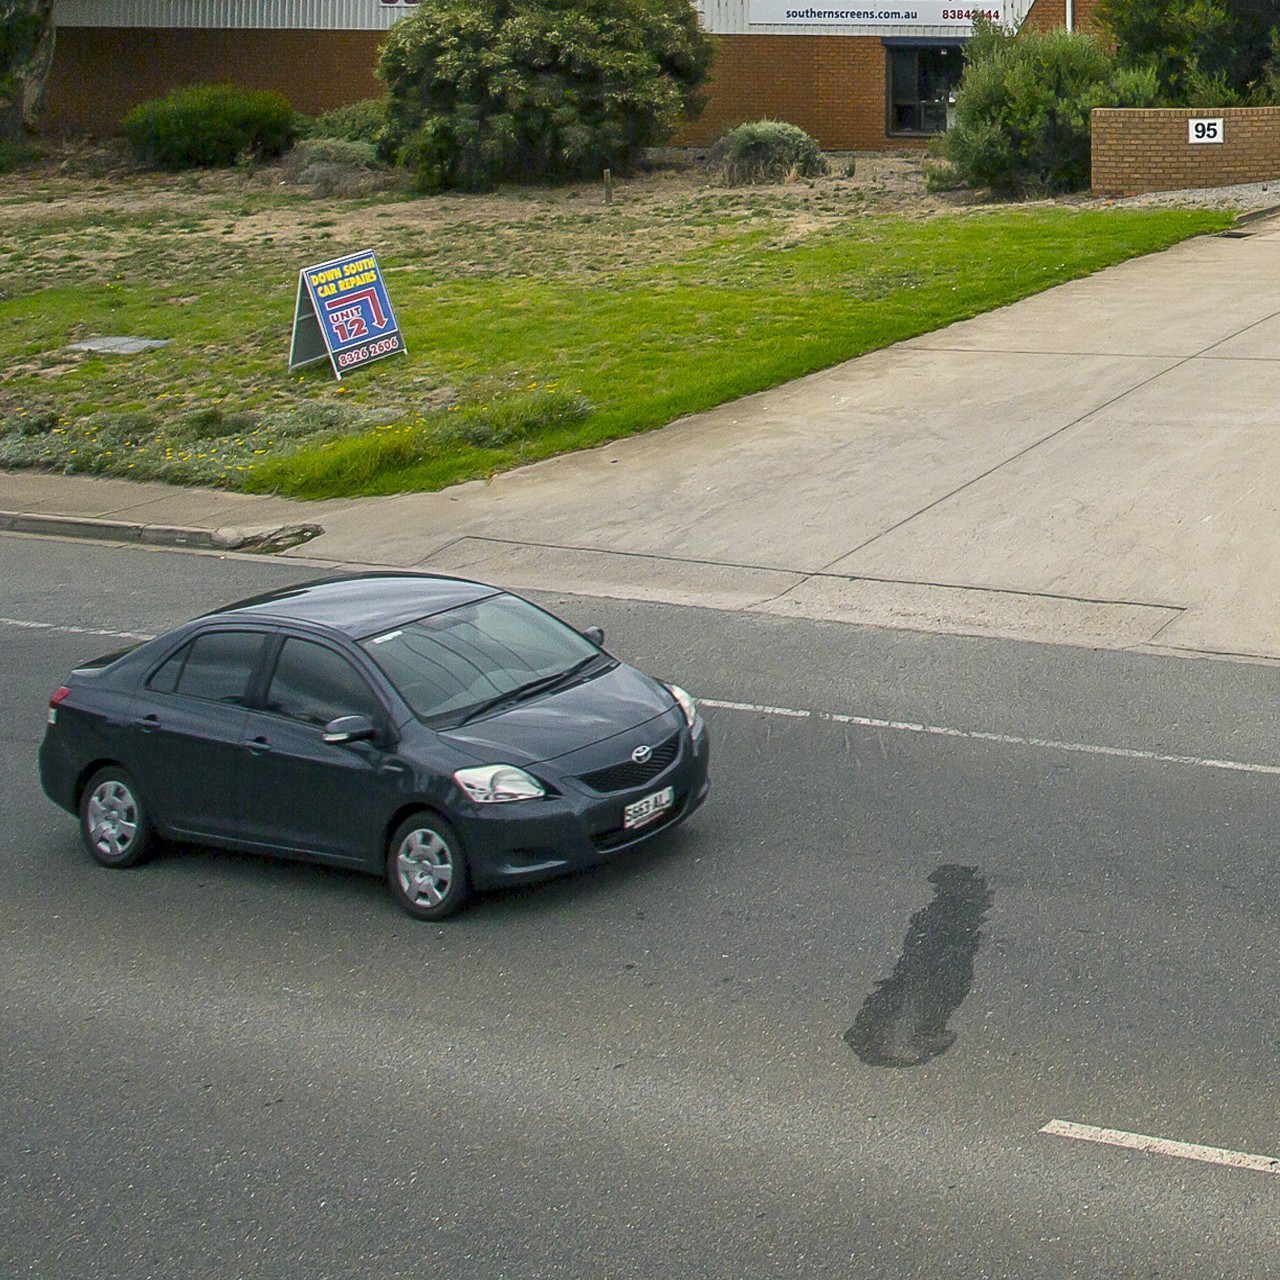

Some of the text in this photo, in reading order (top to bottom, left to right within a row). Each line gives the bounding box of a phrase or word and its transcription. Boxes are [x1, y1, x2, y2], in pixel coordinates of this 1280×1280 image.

[786, 7, 918, 19] southernscreens.com.au
[1194, 121, 1218, 139] 95
[310, 257, 376, 287] DOWN SOUTH
[317, 270, 377, 298] CAR REPAIRS
[330, 306, 362, 324] UNIT
[334, 318, 369, 342] 12
[338, 337, 399, 366] 8326 2606
